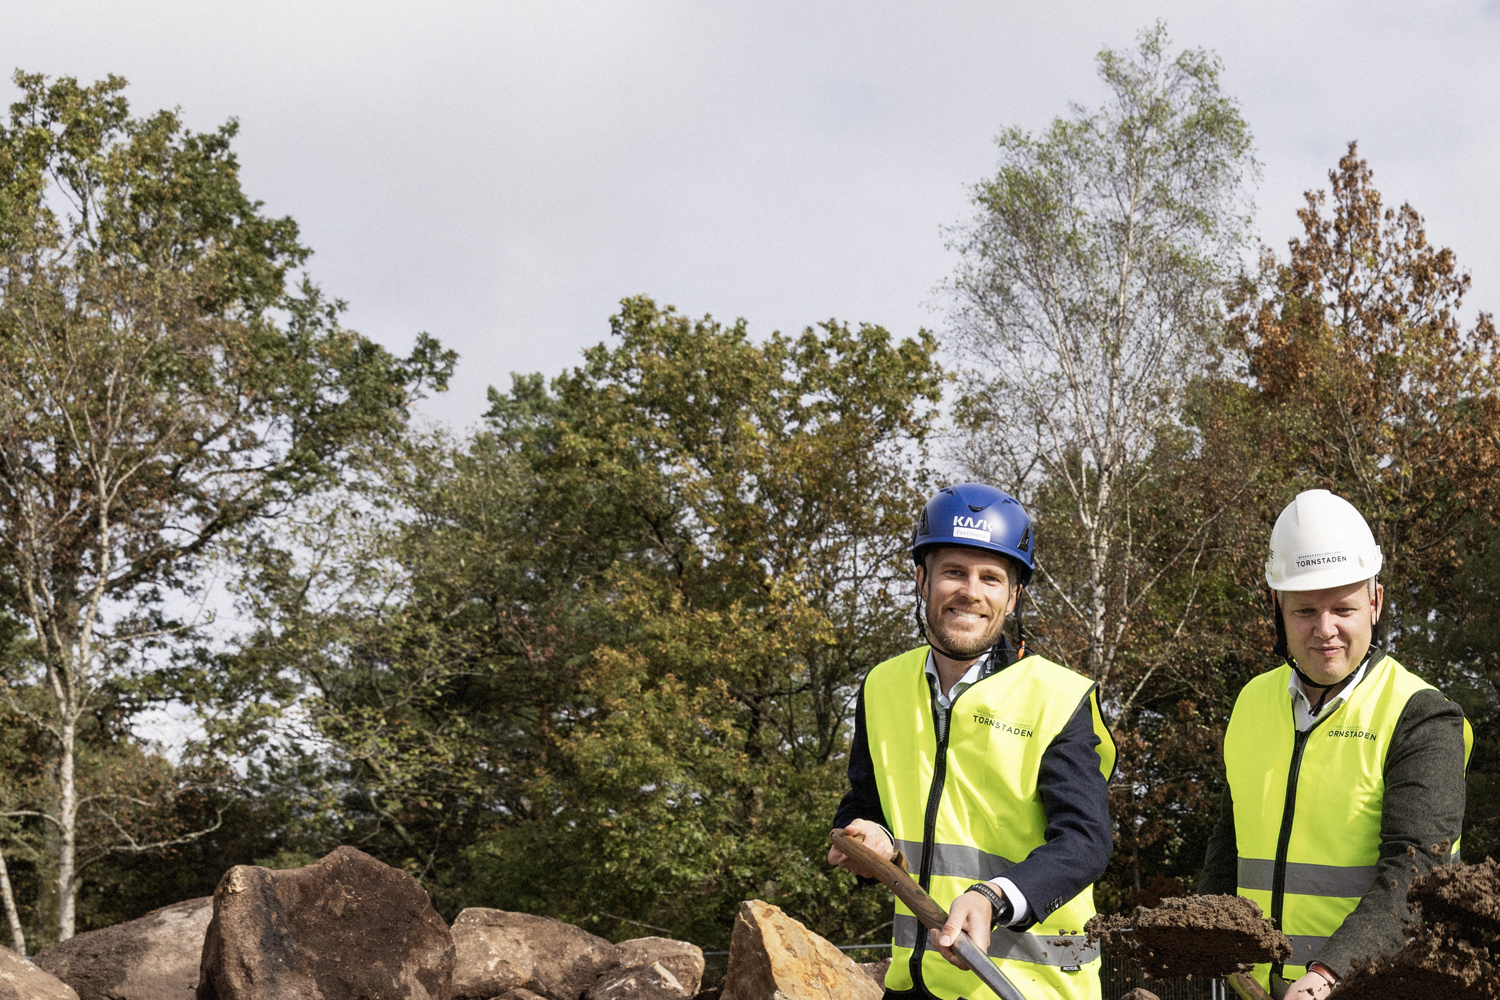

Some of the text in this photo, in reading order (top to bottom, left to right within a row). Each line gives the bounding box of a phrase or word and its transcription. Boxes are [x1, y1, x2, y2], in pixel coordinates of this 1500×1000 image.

[953, 515, 993, 532] KASK
[1296, 555, 1347, 567] TORNSTADEN
[973, 715, 1033, 738] TORNSTADEN
[1326, 730, 1377, 741] ORNSTADEN
